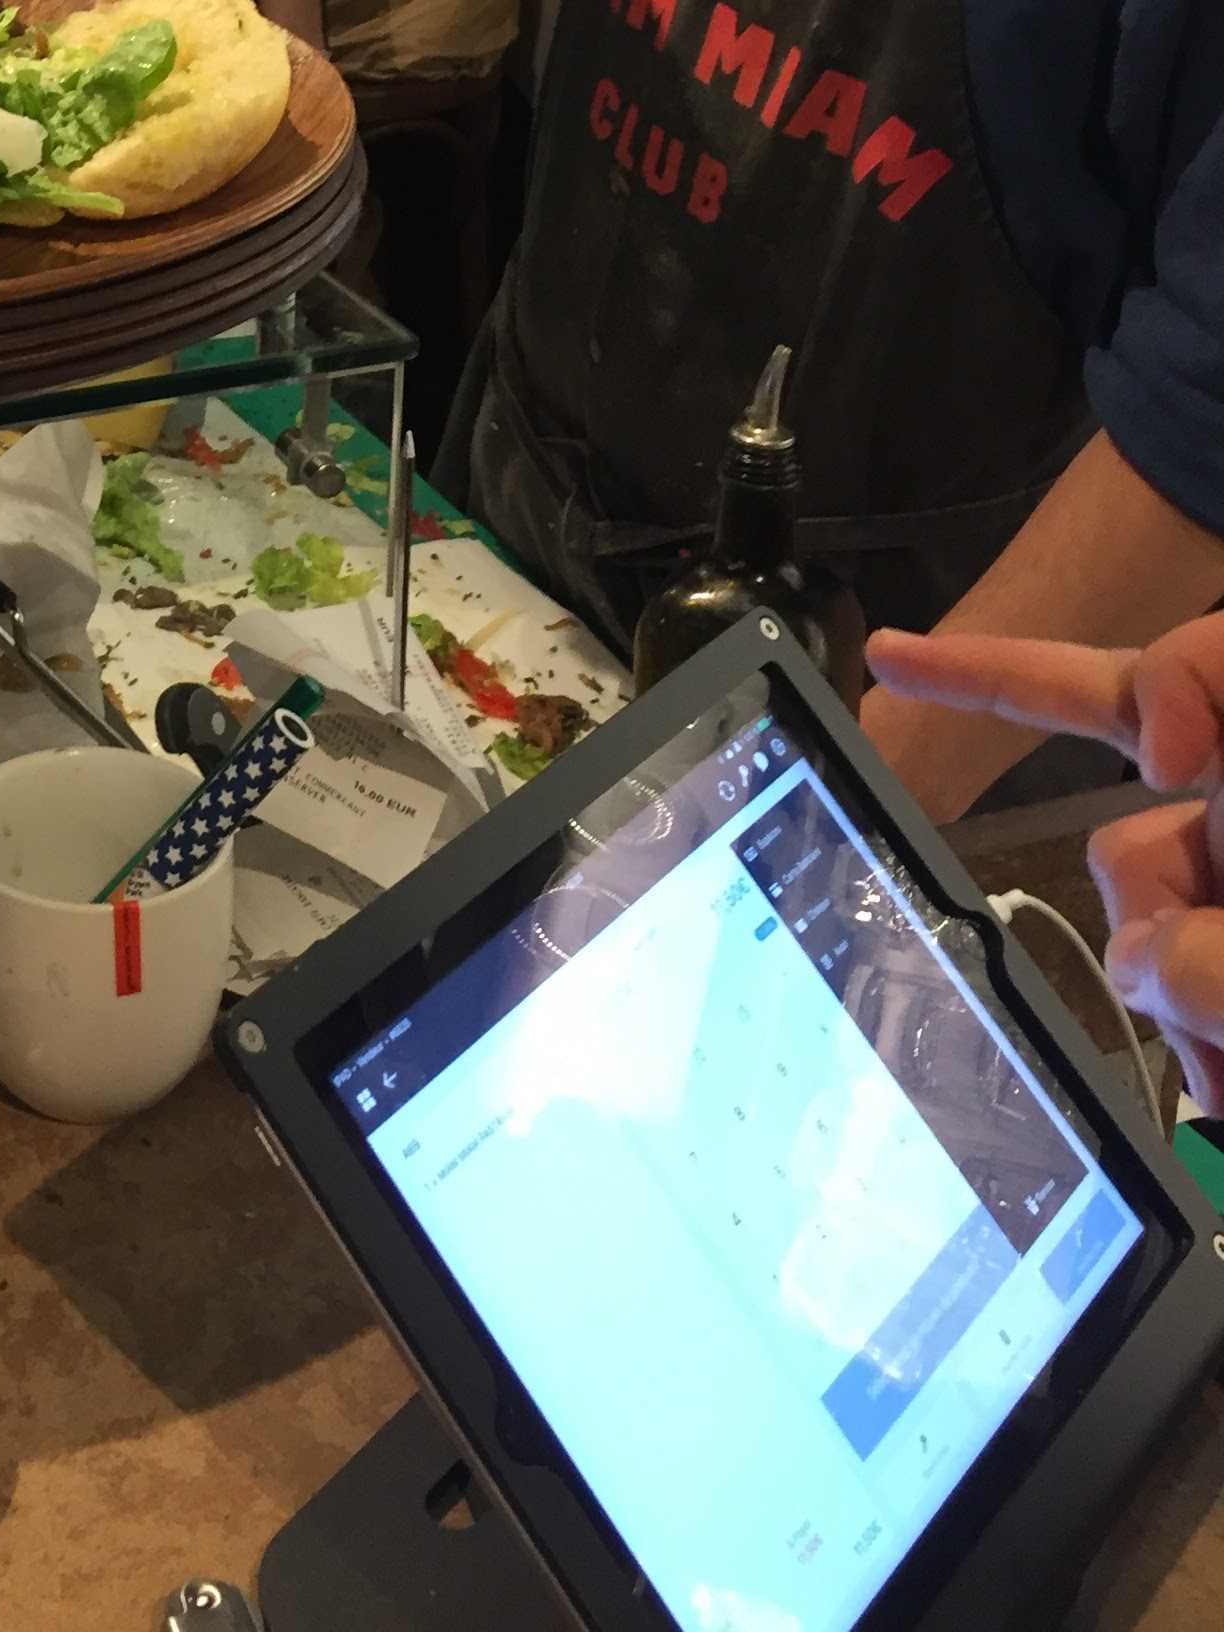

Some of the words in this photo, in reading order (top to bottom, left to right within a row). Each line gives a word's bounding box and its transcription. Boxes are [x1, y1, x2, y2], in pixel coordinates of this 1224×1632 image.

[589, 78, 729, 224] CLUB
[693, 1, 953, 223] MIAM
[386, 798, 417, 819] EUR
